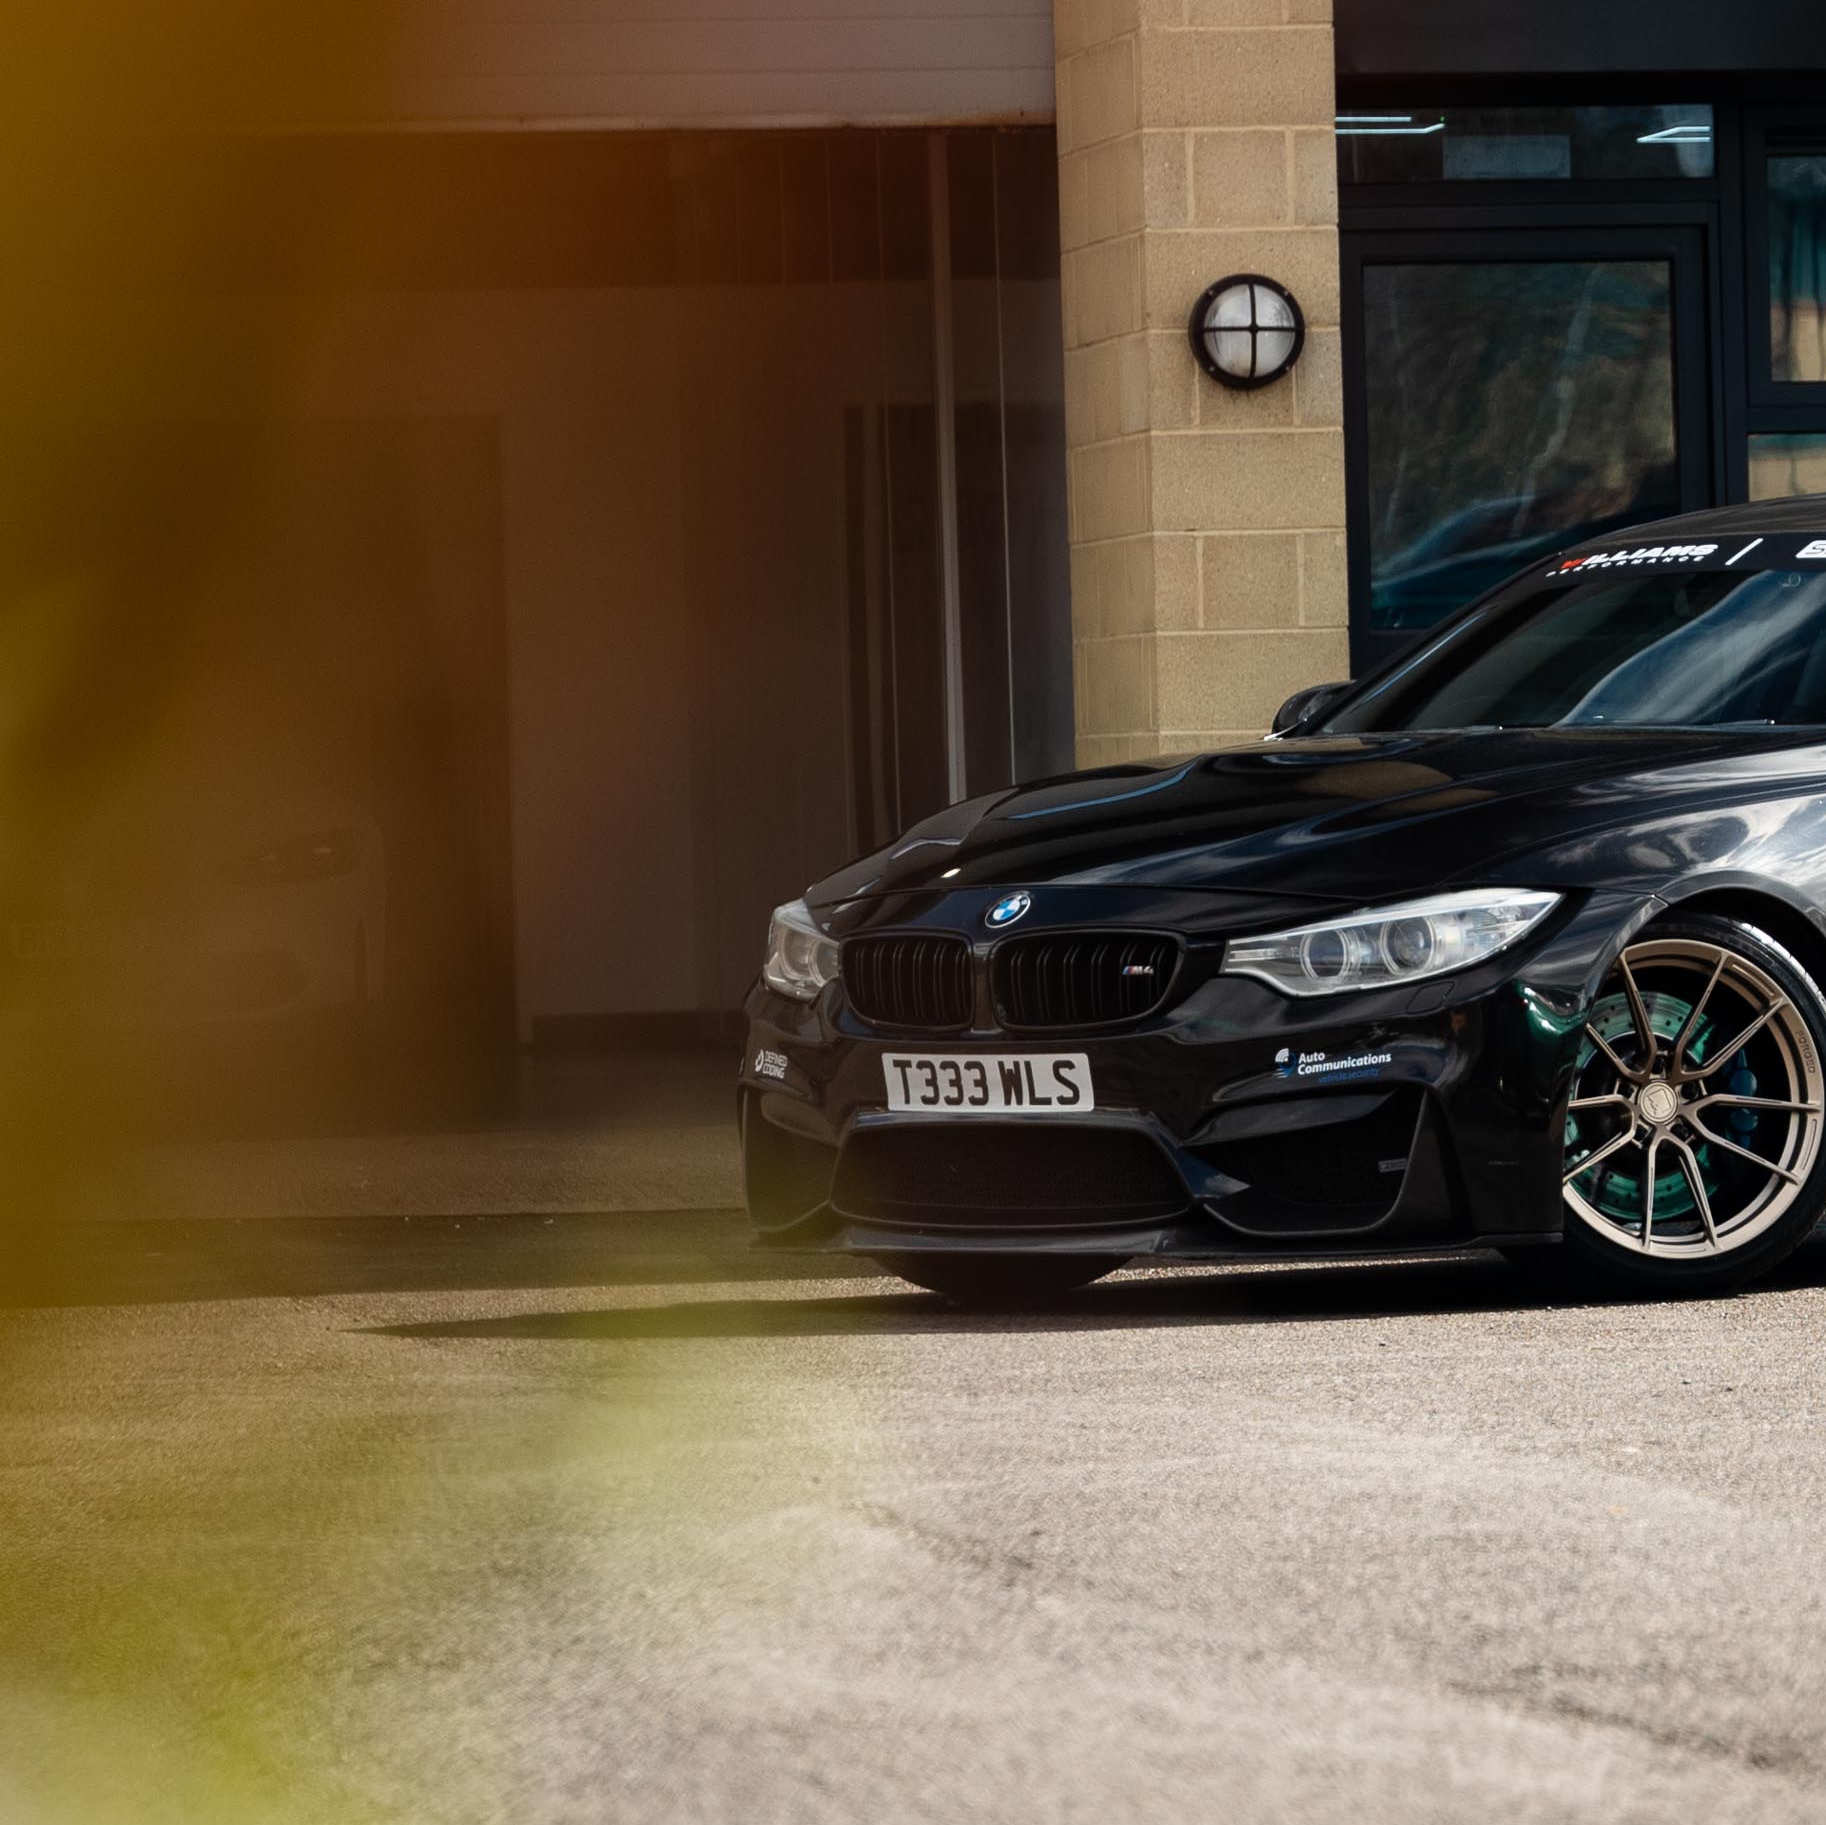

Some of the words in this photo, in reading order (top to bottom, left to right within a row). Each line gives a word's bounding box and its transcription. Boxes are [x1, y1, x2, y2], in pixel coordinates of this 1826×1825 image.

[1561, 543, 1719, 569] WILLIAMS
[1297, 1053, 1392, 1075] Communications
[1298, 1051, 1326, 1064] Auto
[1795, 1030, 1816, 1074] FORGED
[892, 1059, 990, 1106] T333
[997, 1060, 1080, 1106] WLS
